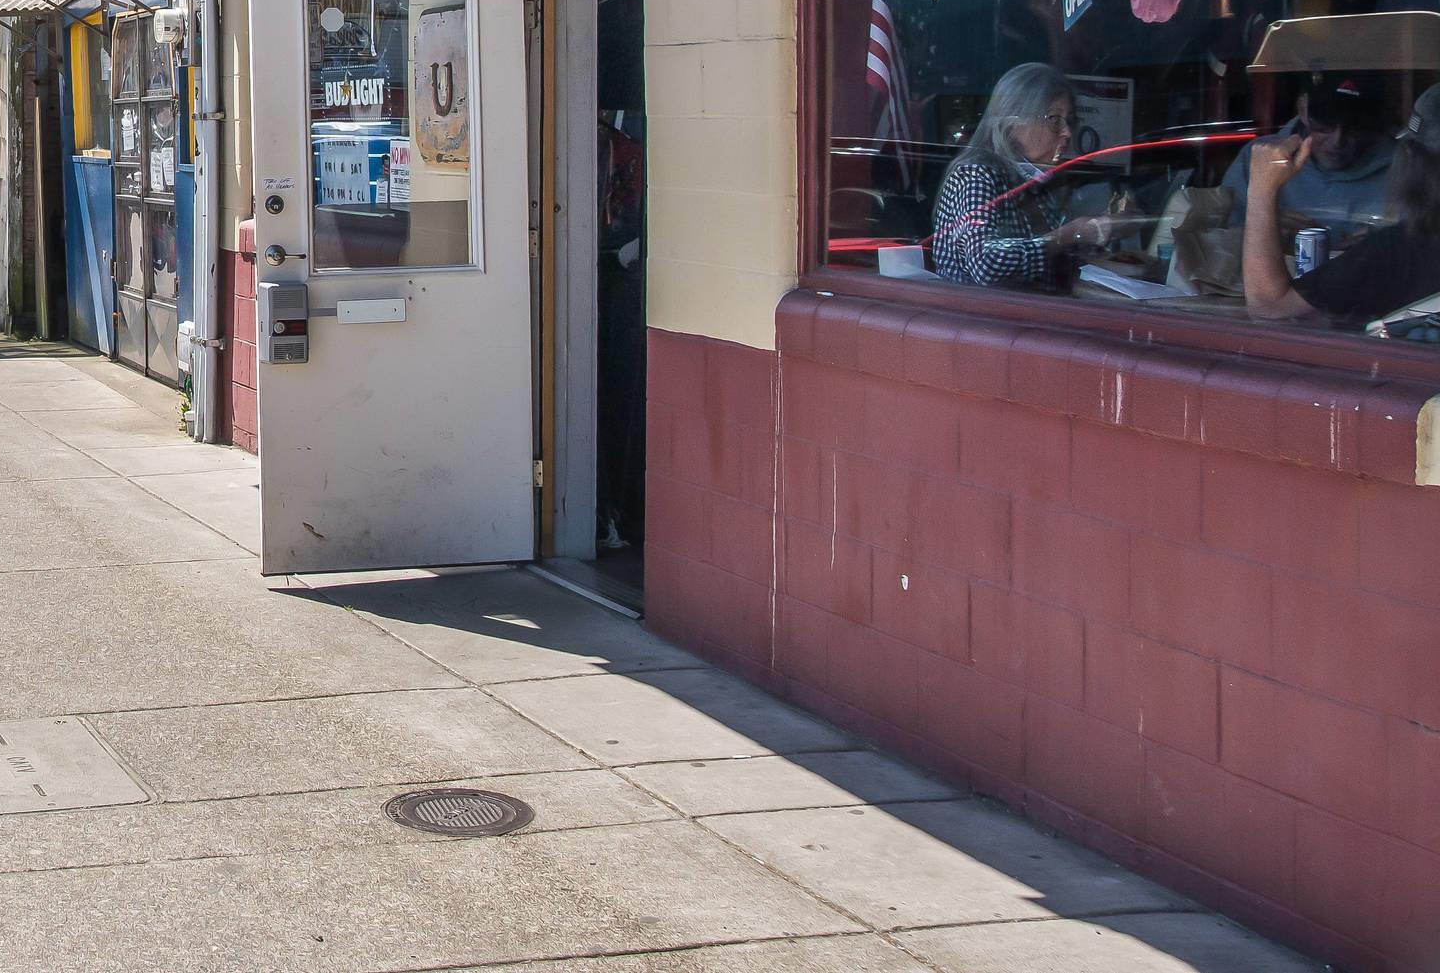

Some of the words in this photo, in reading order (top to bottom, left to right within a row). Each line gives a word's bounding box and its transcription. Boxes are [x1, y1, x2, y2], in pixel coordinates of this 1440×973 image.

[324, 81, 350, 106] BUD
[349, 78, 384, 105] LIGHT
[391, 147, 399, 164] NO
[324, 162, 336, 173] FRI
[351, 163, 362, 174] SAT
